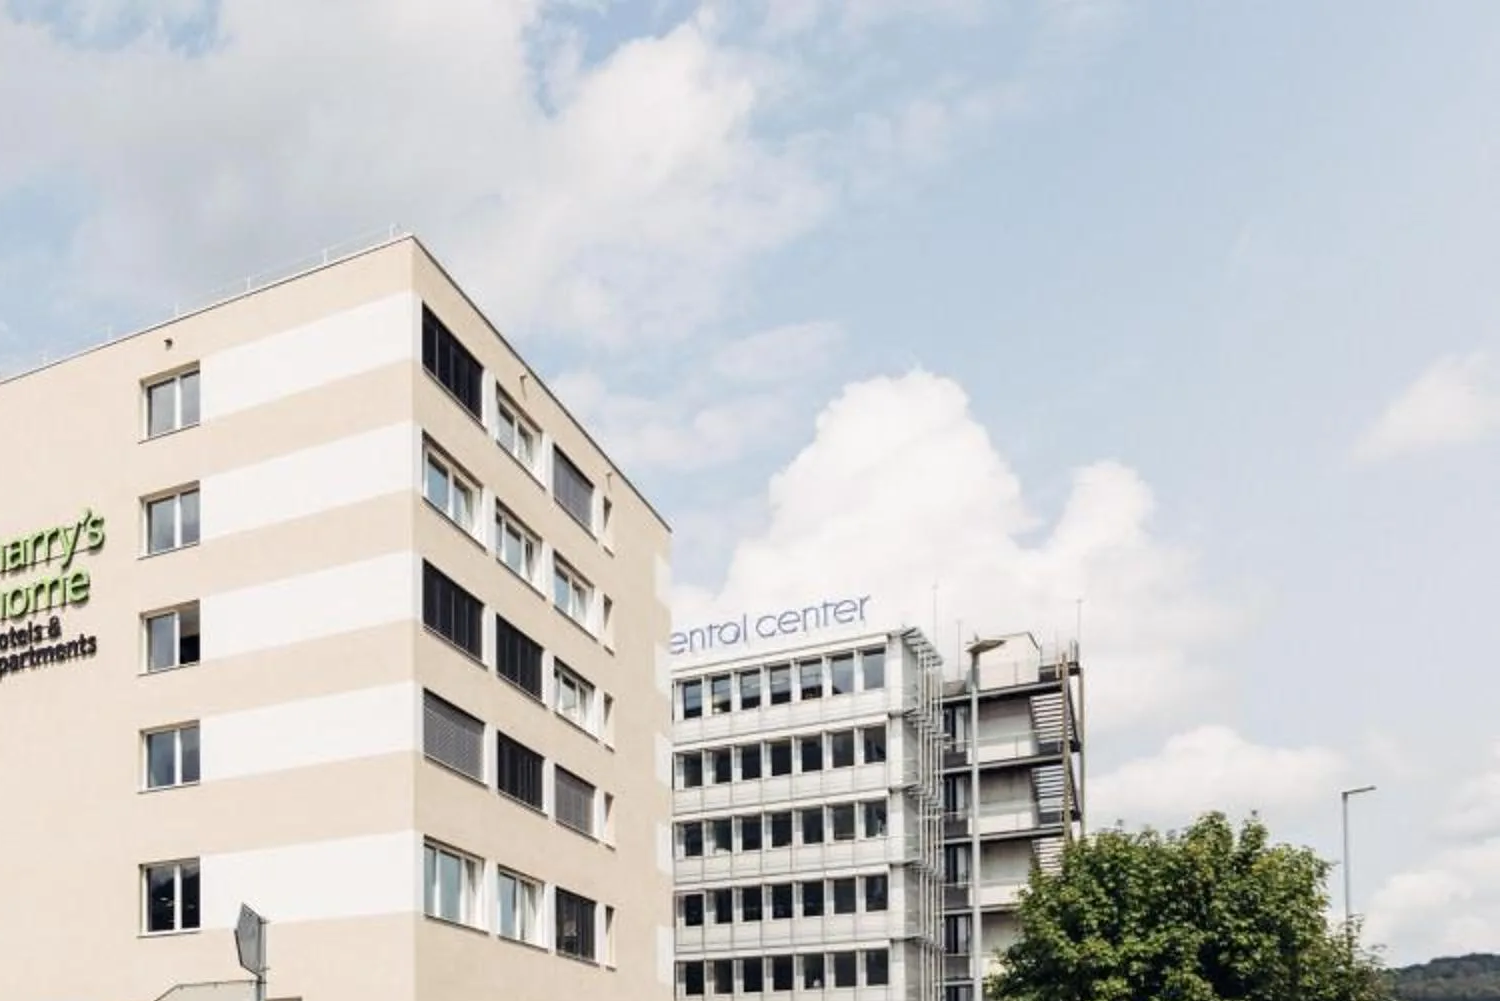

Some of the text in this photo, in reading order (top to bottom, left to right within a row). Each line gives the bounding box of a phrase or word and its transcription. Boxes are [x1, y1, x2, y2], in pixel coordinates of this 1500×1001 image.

[48, 614, 62, 641] &
[668, 595, 870, 655] ental center
